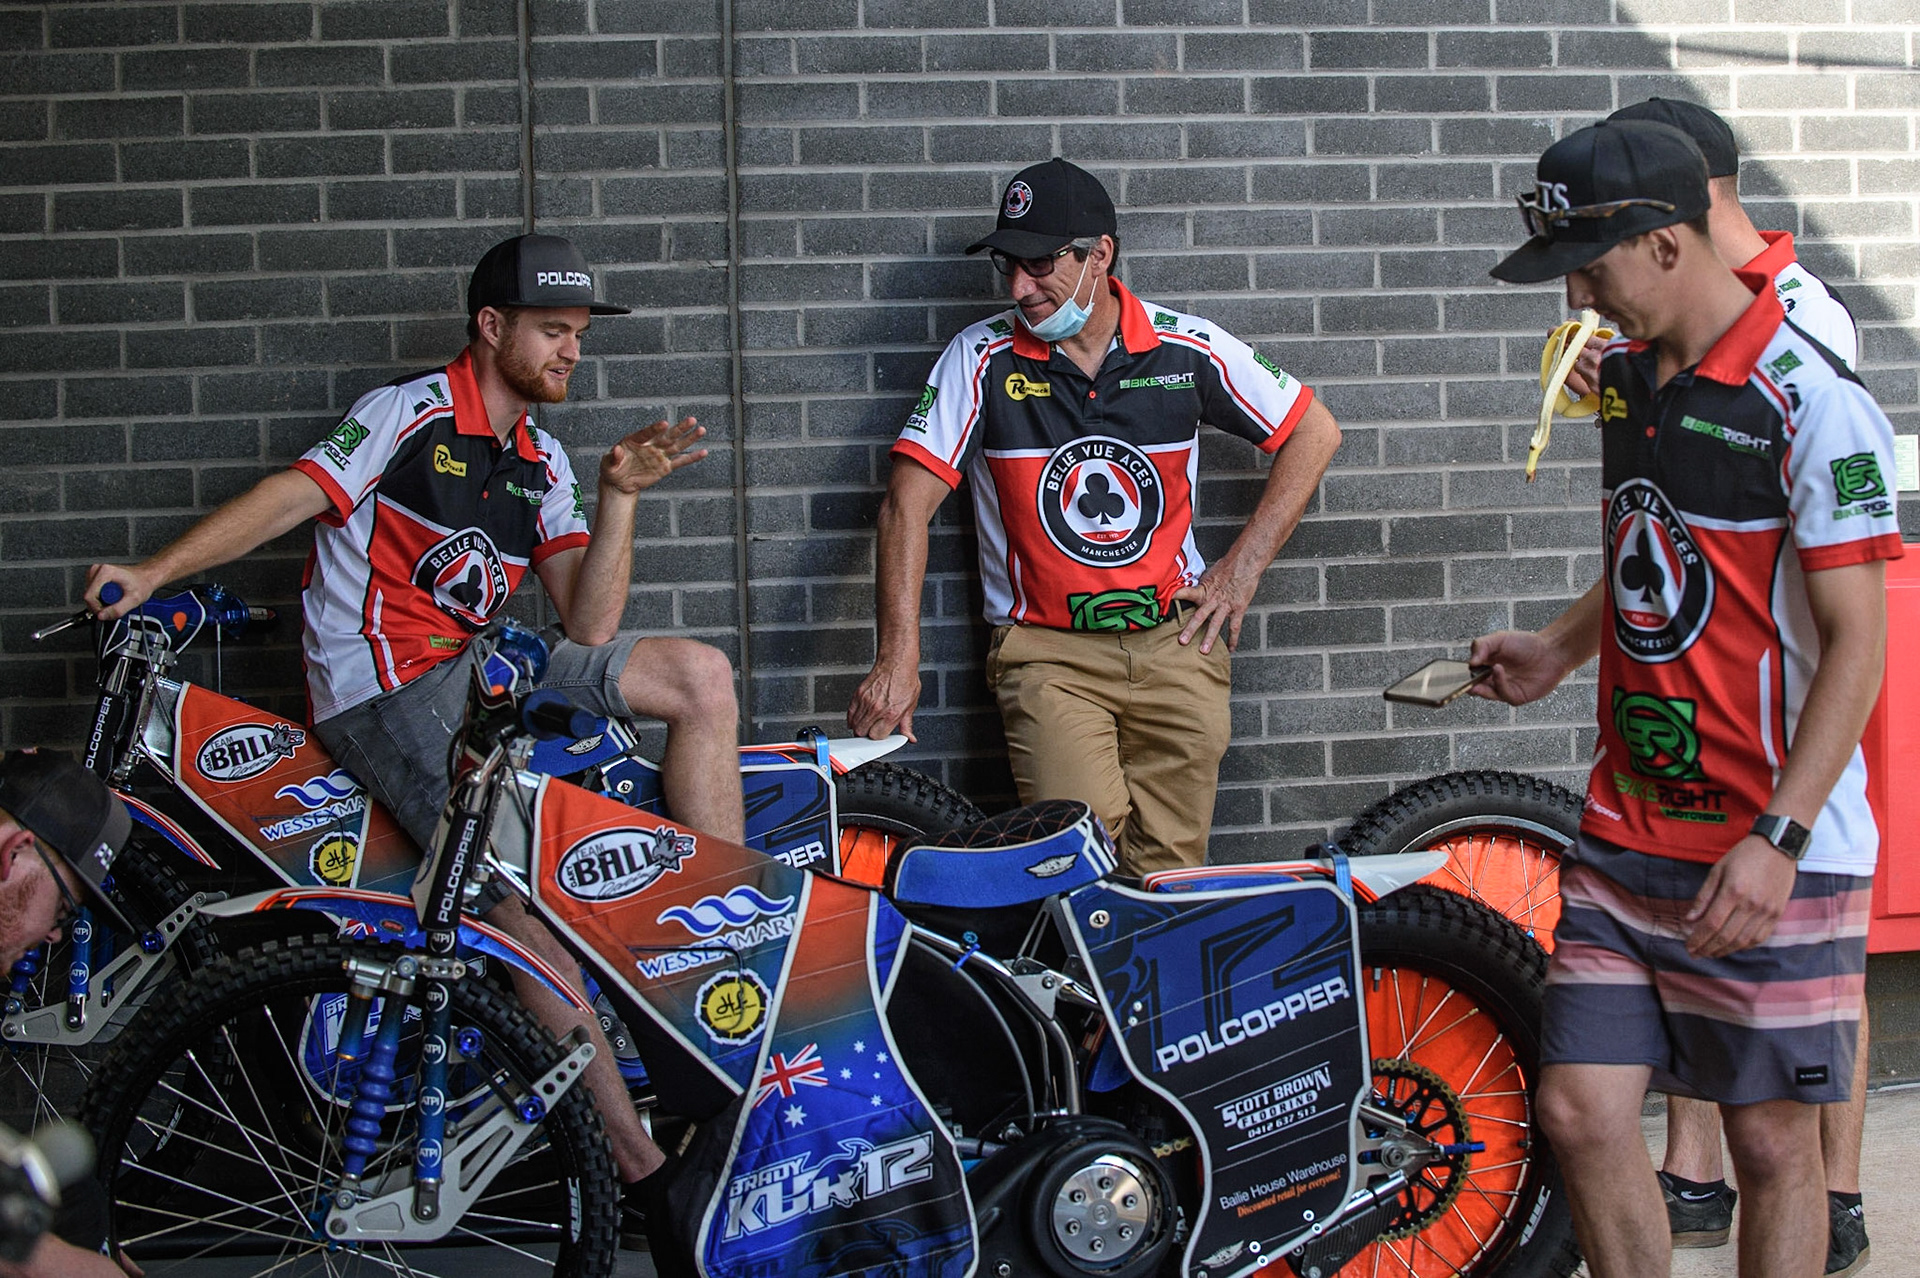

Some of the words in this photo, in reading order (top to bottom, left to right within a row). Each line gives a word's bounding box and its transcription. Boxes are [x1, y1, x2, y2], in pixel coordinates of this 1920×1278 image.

[1130, 373, 1194, 388] BIKERIGHT
[1081, 444, 1115, 458] VUE
[1120, 453, 1153, 488] ACES
[1663, 515, 1698, 565] ACES
[429, 536, 471, 569] BELLE
[473, 535, 488, 555] VUE
[487, 555, 505, 594] ACES
[84, 696, 113, 769] OLCOPPER
[209, 733, 276, 771] BALL
[437, 818, 478, 923] POLCOPPER
[572, 841, 657, 887] BALL
[573, 843, 606, 862] TEAM
[73, 927, 90, 936] ATPI
[432, 932, 451, 943] ATPI
[70, 968, 88, 977] ATPI
[427, 990, 444, 1001] ATPI
[1156, 976, 1351, 1073] POLCOPPER
[424, 1043, 441, 1054] ATPI
[422, 1096, 440, 1106] ATPI
[1221, 1090, 1270, 1128] SCOTT
[1272, 1066, 1332, 1101] BROWN
[1241, 1090, 1316, 1129] FLOORING
[1247, 1123, 1275, 1139] 0412
[1275, 1114, 1295, 1129] 637
[1297, 1105, 1317, 1119] 513
[419, 1147, 438, 1158] ATPI
[730, 1156, 805, 1197] BRADY
[1219, 1190, 1250, 1210] Bailie
[1250, 1176, 1287, 1199] House
[1286, 1153, 1347, 1183] Warehouse
[1237, 1192, 1277, 1218] Discounted
[1277, 1186, 1296, 1202] retail
[1295, 1184, 1308, 1198] for
[1307, 1169, 1341, 1189] everyone!
